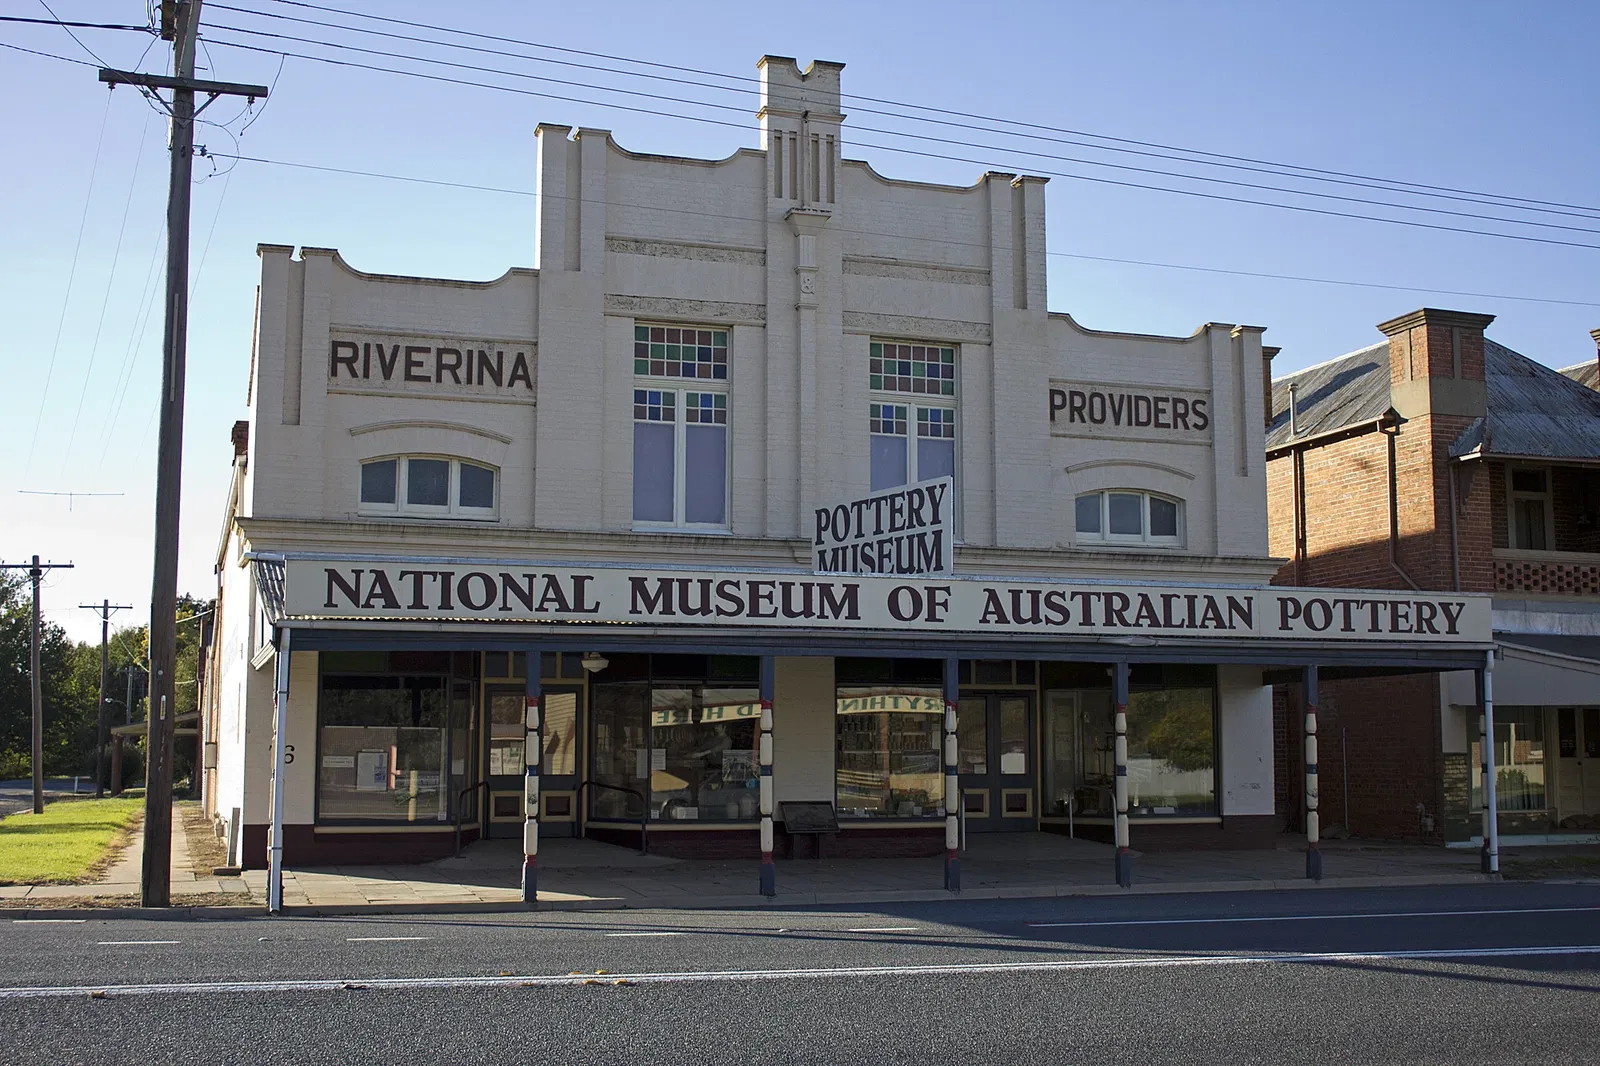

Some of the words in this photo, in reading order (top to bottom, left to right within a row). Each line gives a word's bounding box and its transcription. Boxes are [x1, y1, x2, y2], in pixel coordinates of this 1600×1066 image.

[330, 340, 533, 391] RIVERINA
[1049, 388, 1209, 431] PROVIDERS
[815, 483, 947, 546] POTTERY
[817, 529, 944, 575] MUSEUM
[323, 568, 601, 614] NATIONAL
[628, 576, 861, 620] MUSEUM
[887, 585, 951, 622] OF
[979, 587, 1253, 631] AUSTRALIAN
[1277, 596, 1466, 635] POTTERY
